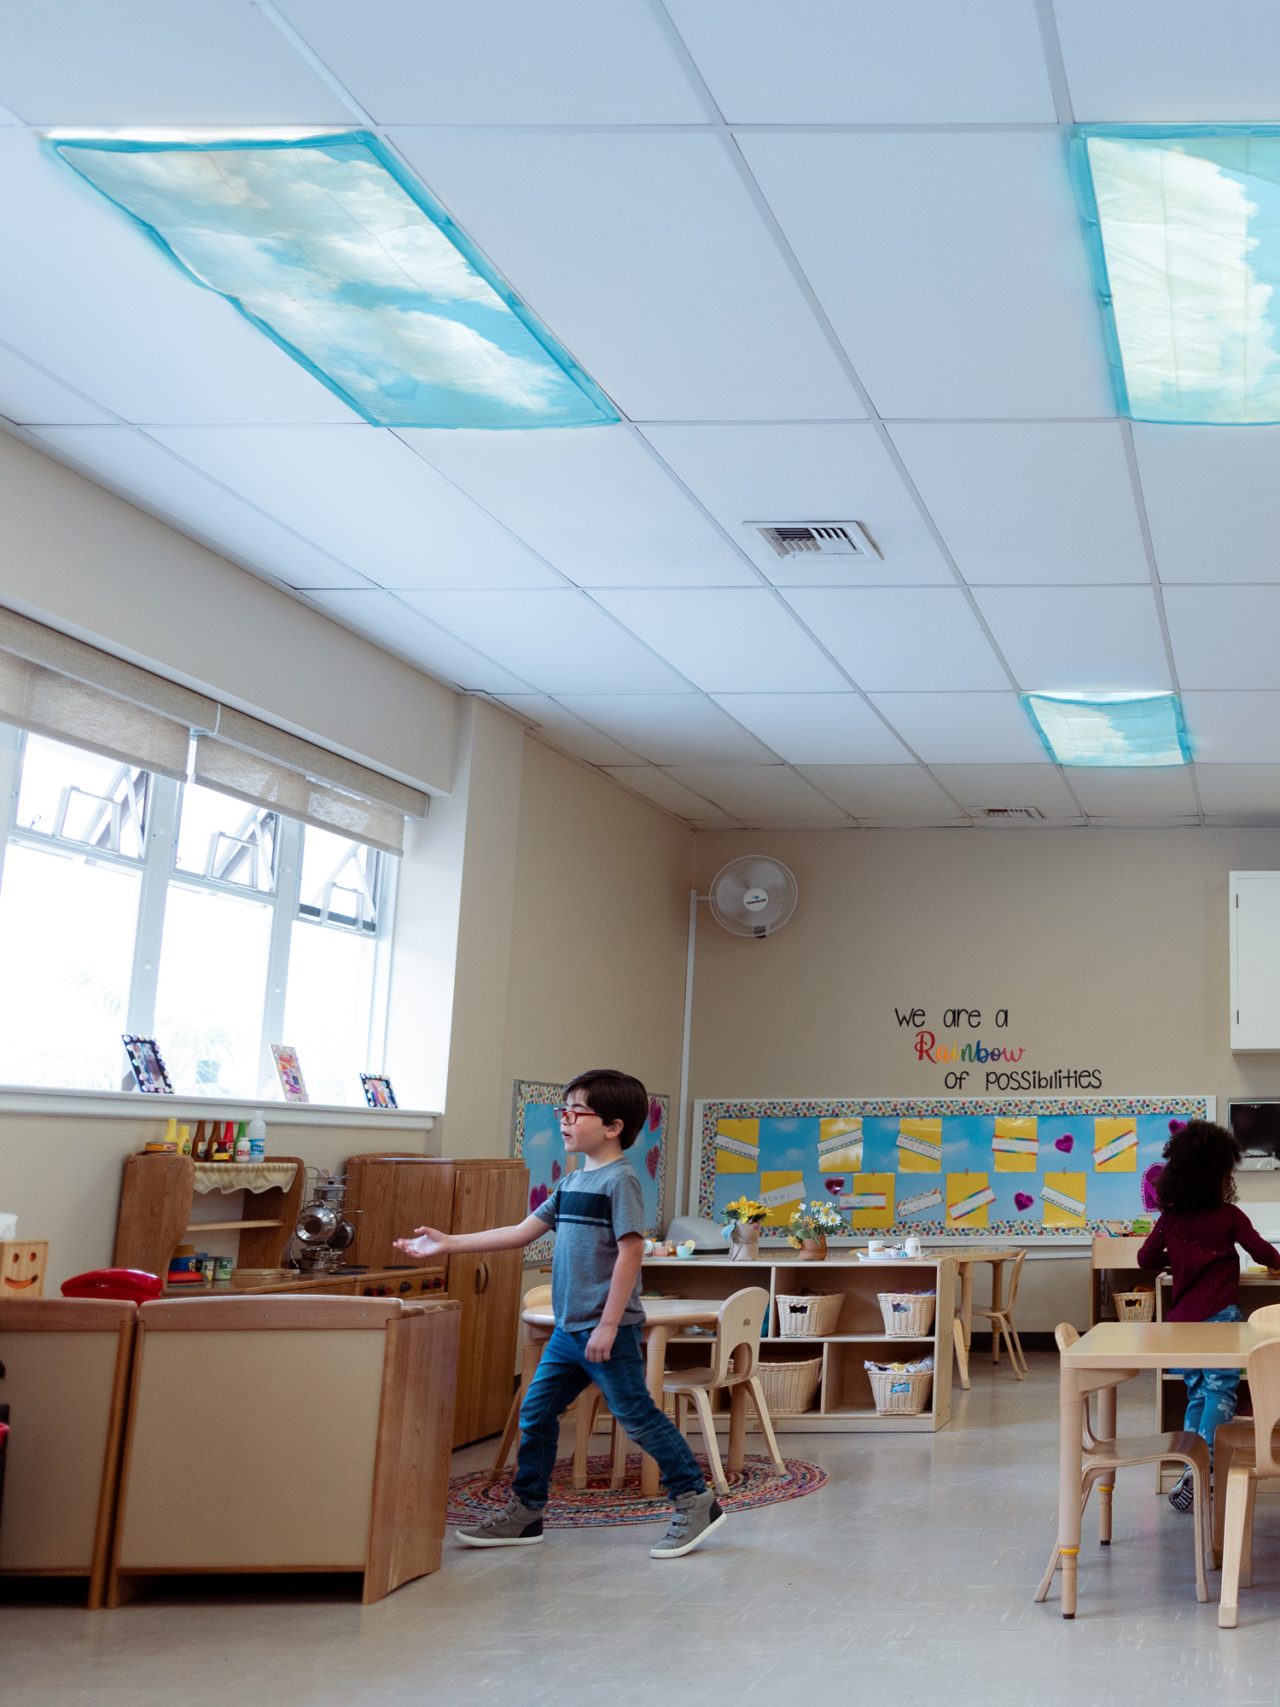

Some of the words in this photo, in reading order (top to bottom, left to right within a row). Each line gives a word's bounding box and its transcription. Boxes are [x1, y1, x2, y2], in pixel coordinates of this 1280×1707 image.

[943, 1008, 981, 1028] are
[995, 1008, 1009, 1028] a
[914, 1030, 1026, 1064] Rainbow
